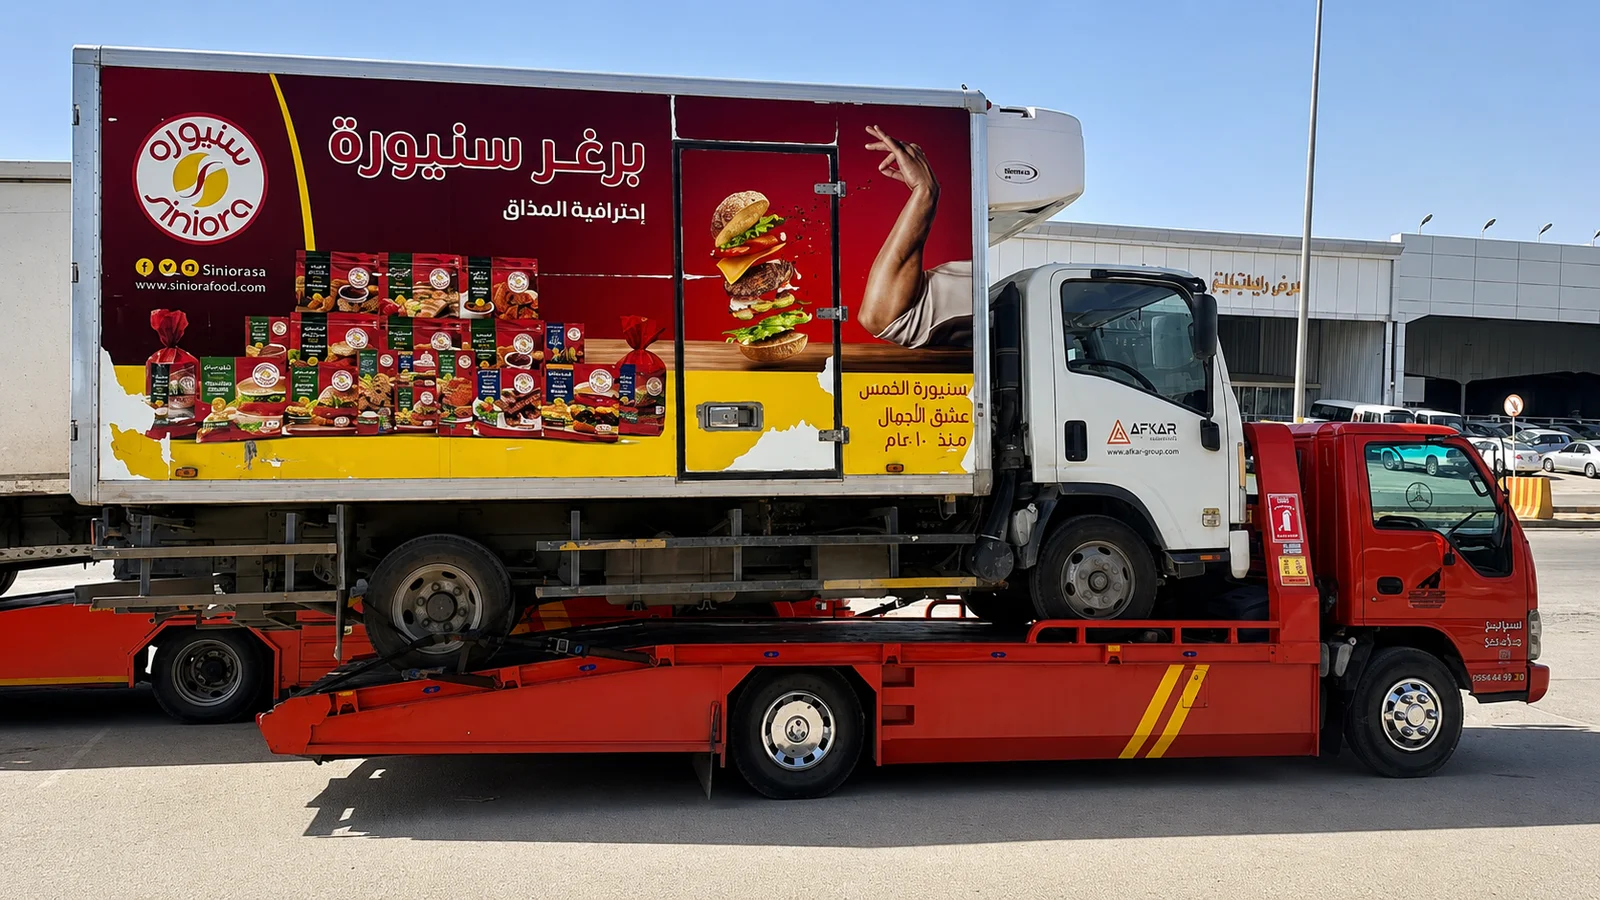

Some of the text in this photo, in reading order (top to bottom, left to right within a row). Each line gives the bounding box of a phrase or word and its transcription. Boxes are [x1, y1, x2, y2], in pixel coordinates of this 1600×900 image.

[328, 116, 645, 187] برغر سنيورة
[503, 199, 567, 220] المذاق
[202, 264, 266, 277] Siniorasa
[135, 281, 266, 293] www.siniorafood.com
[913, 381, 968, 400] سنيورة
[930, 407, 969, 427] عشق
[1130, 423, 1177, 434] AFKAR
[938, 433, 967, 447] منذ
[1107, 448, 1179, 456] www.afkar-group.com
